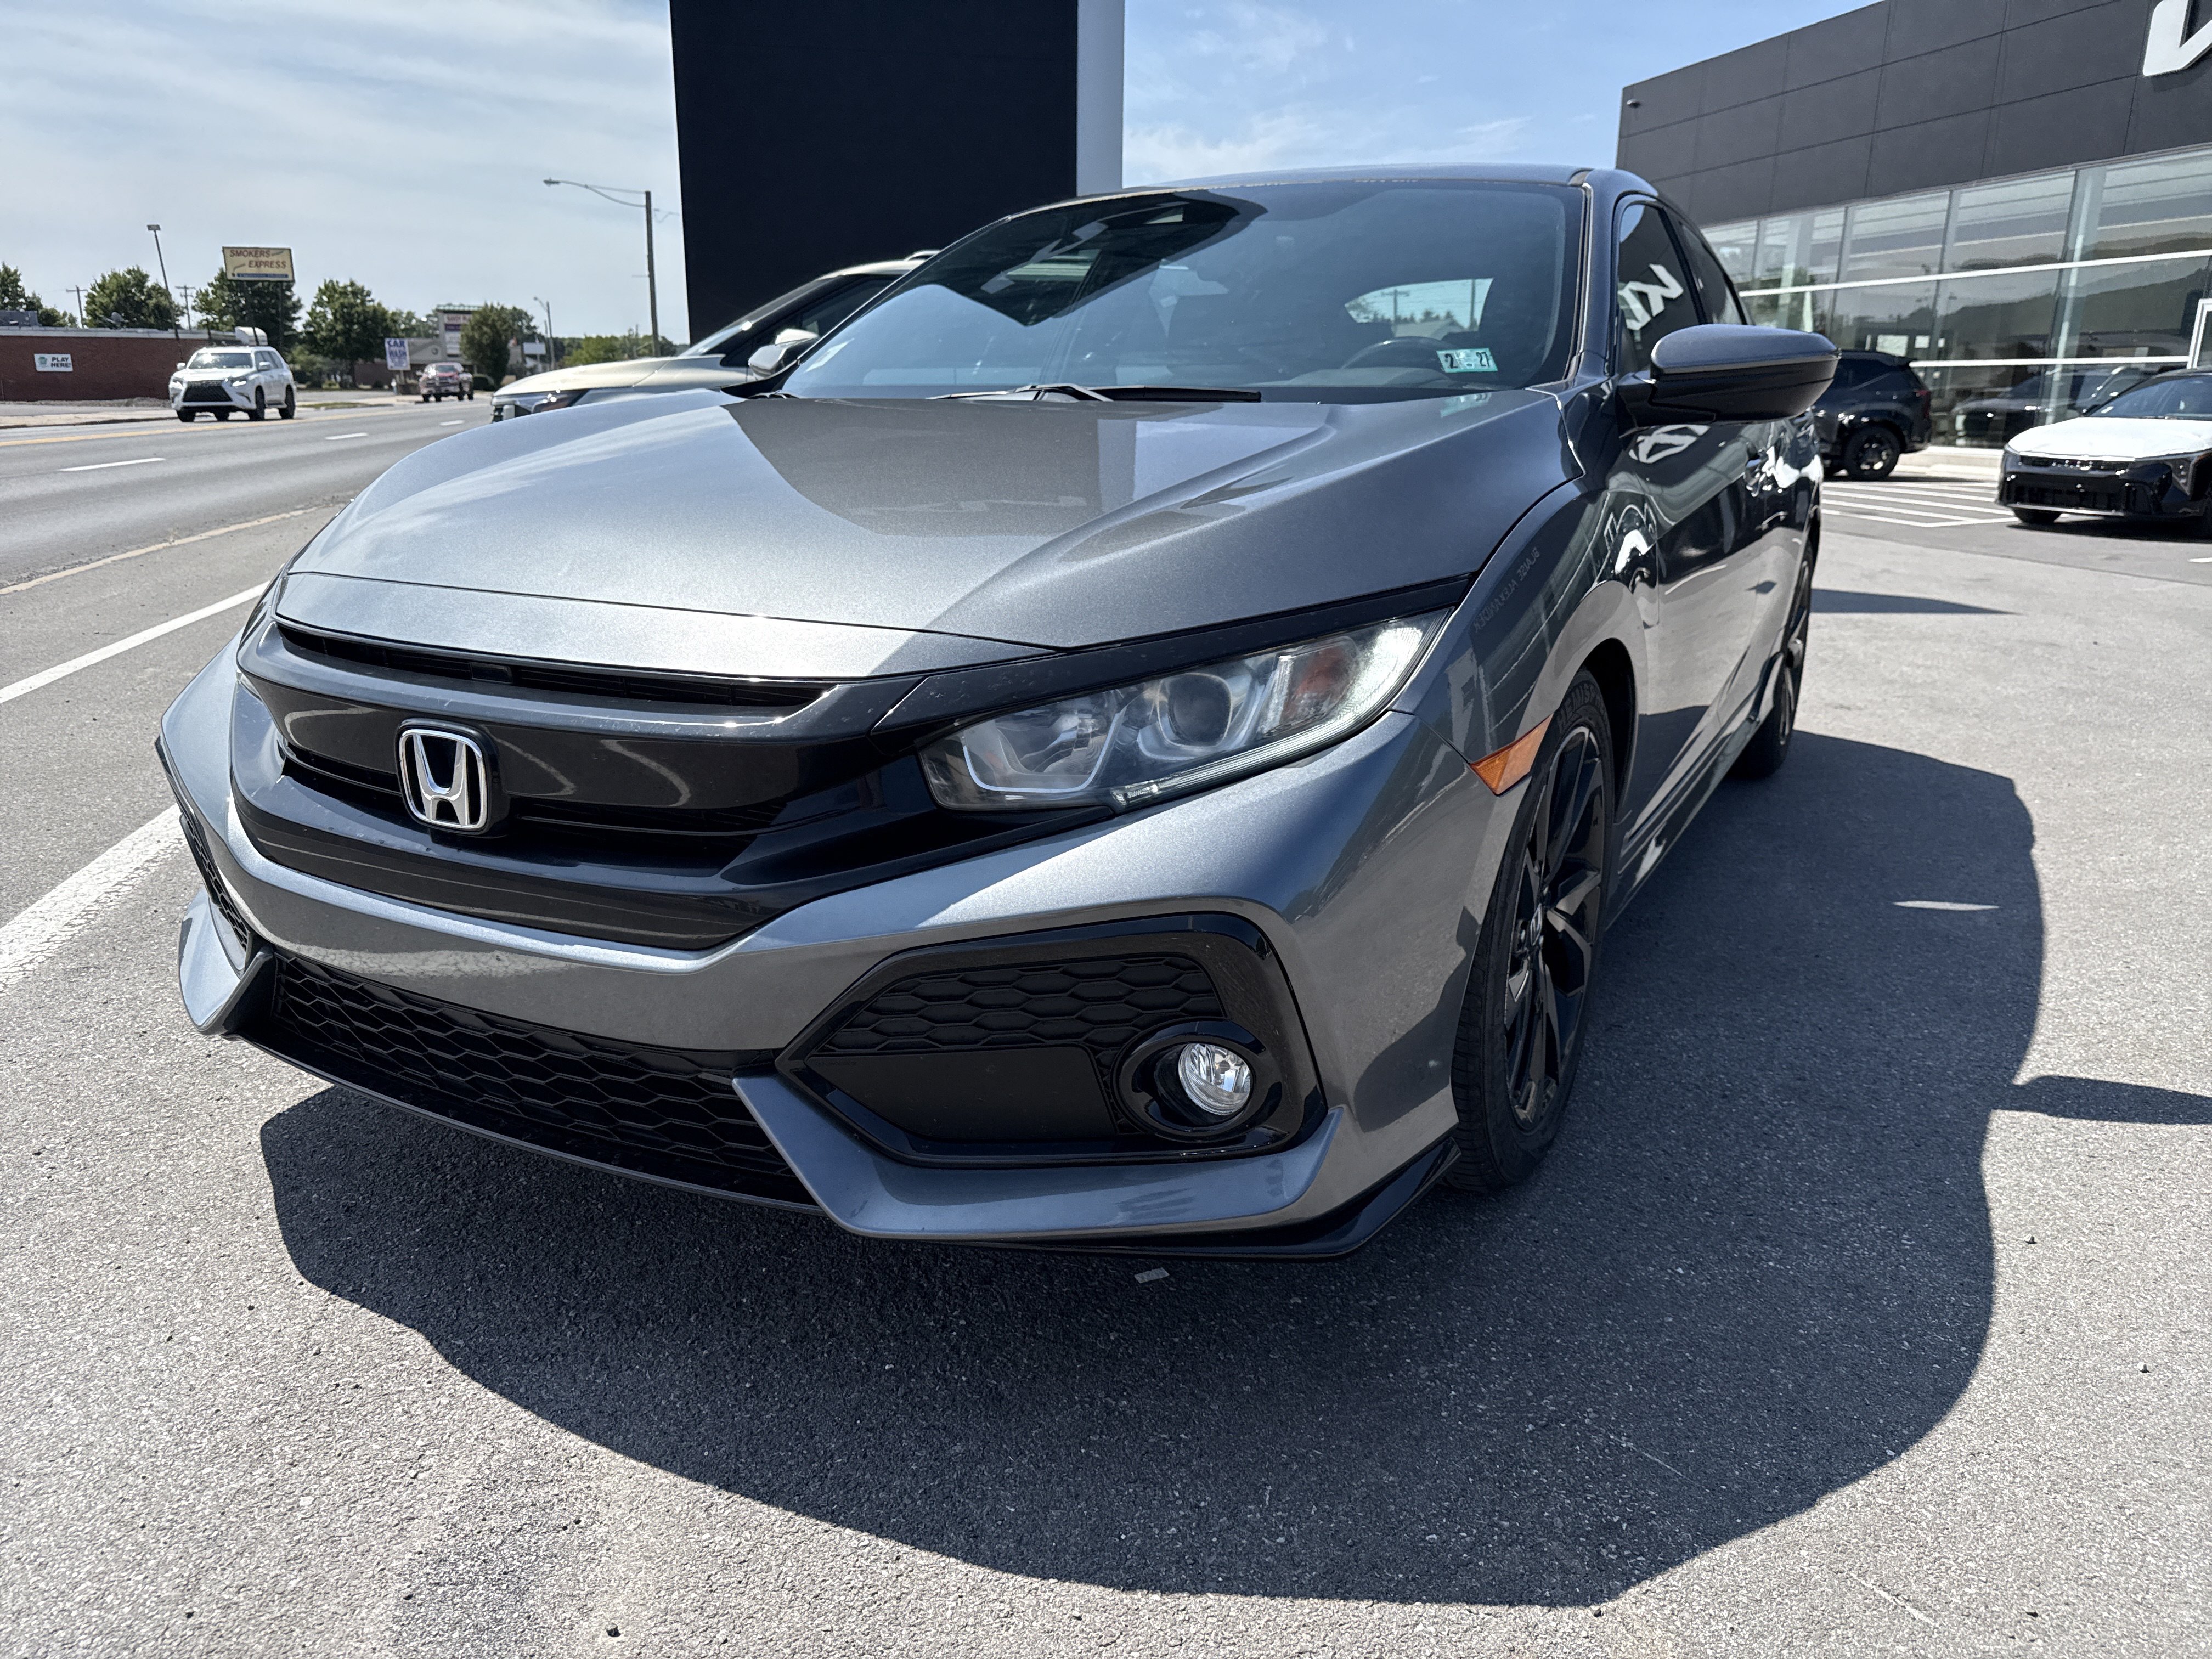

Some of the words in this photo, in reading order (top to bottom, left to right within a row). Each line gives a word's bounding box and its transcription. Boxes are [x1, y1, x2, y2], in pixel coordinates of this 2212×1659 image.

[230, 249, 270, 258] SMOKERS
[249, 260, 286, 269] EXPRESS
[387, 338, 405, 348] CAR
[1444, 353, 1458, 369] 2
[1476, 352, 1490, 367] 27
